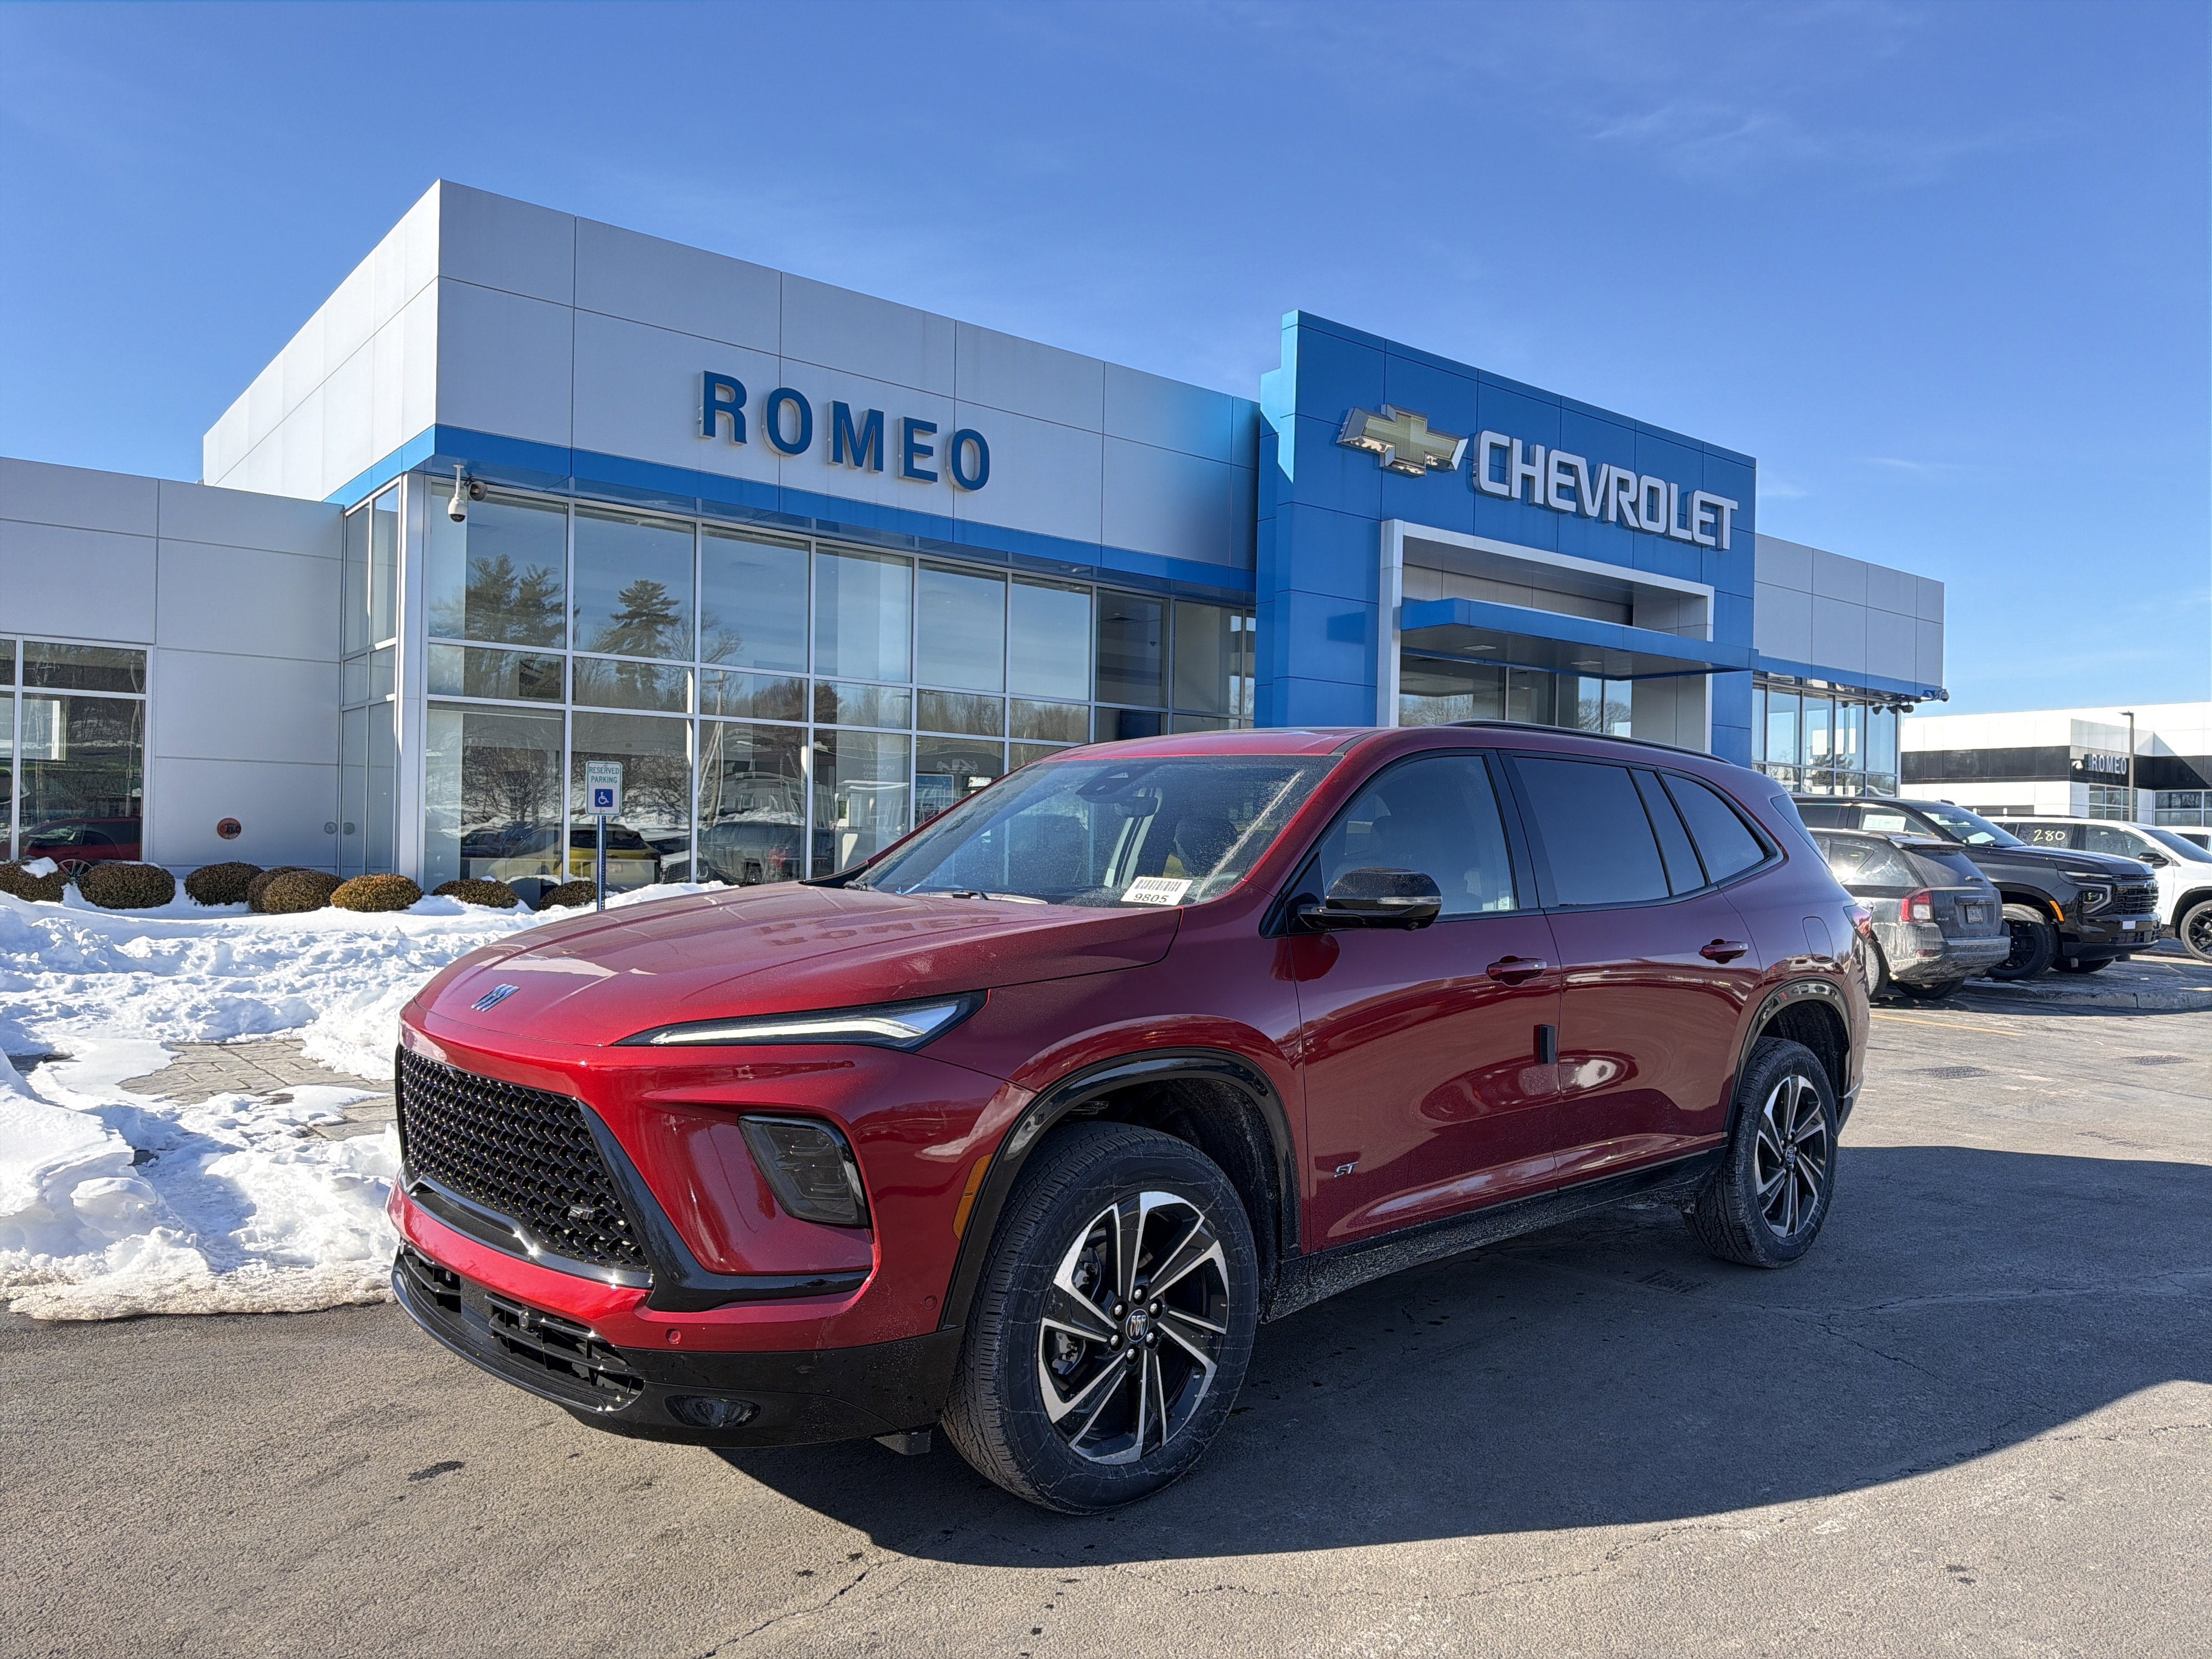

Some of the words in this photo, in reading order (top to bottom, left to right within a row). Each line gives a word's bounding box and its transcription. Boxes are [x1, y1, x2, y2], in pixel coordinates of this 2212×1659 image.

[699, 370, 990, 492] ROMEO
[1475, 431, 1738, 550] CHEVROLET
[2090, 754, 2127, 775] ROMEO
[2033, 830, 2066, 842] 280
[1133, 893, 1169, 902] 9805
[1334, 1161, 1358, 1178] ST
